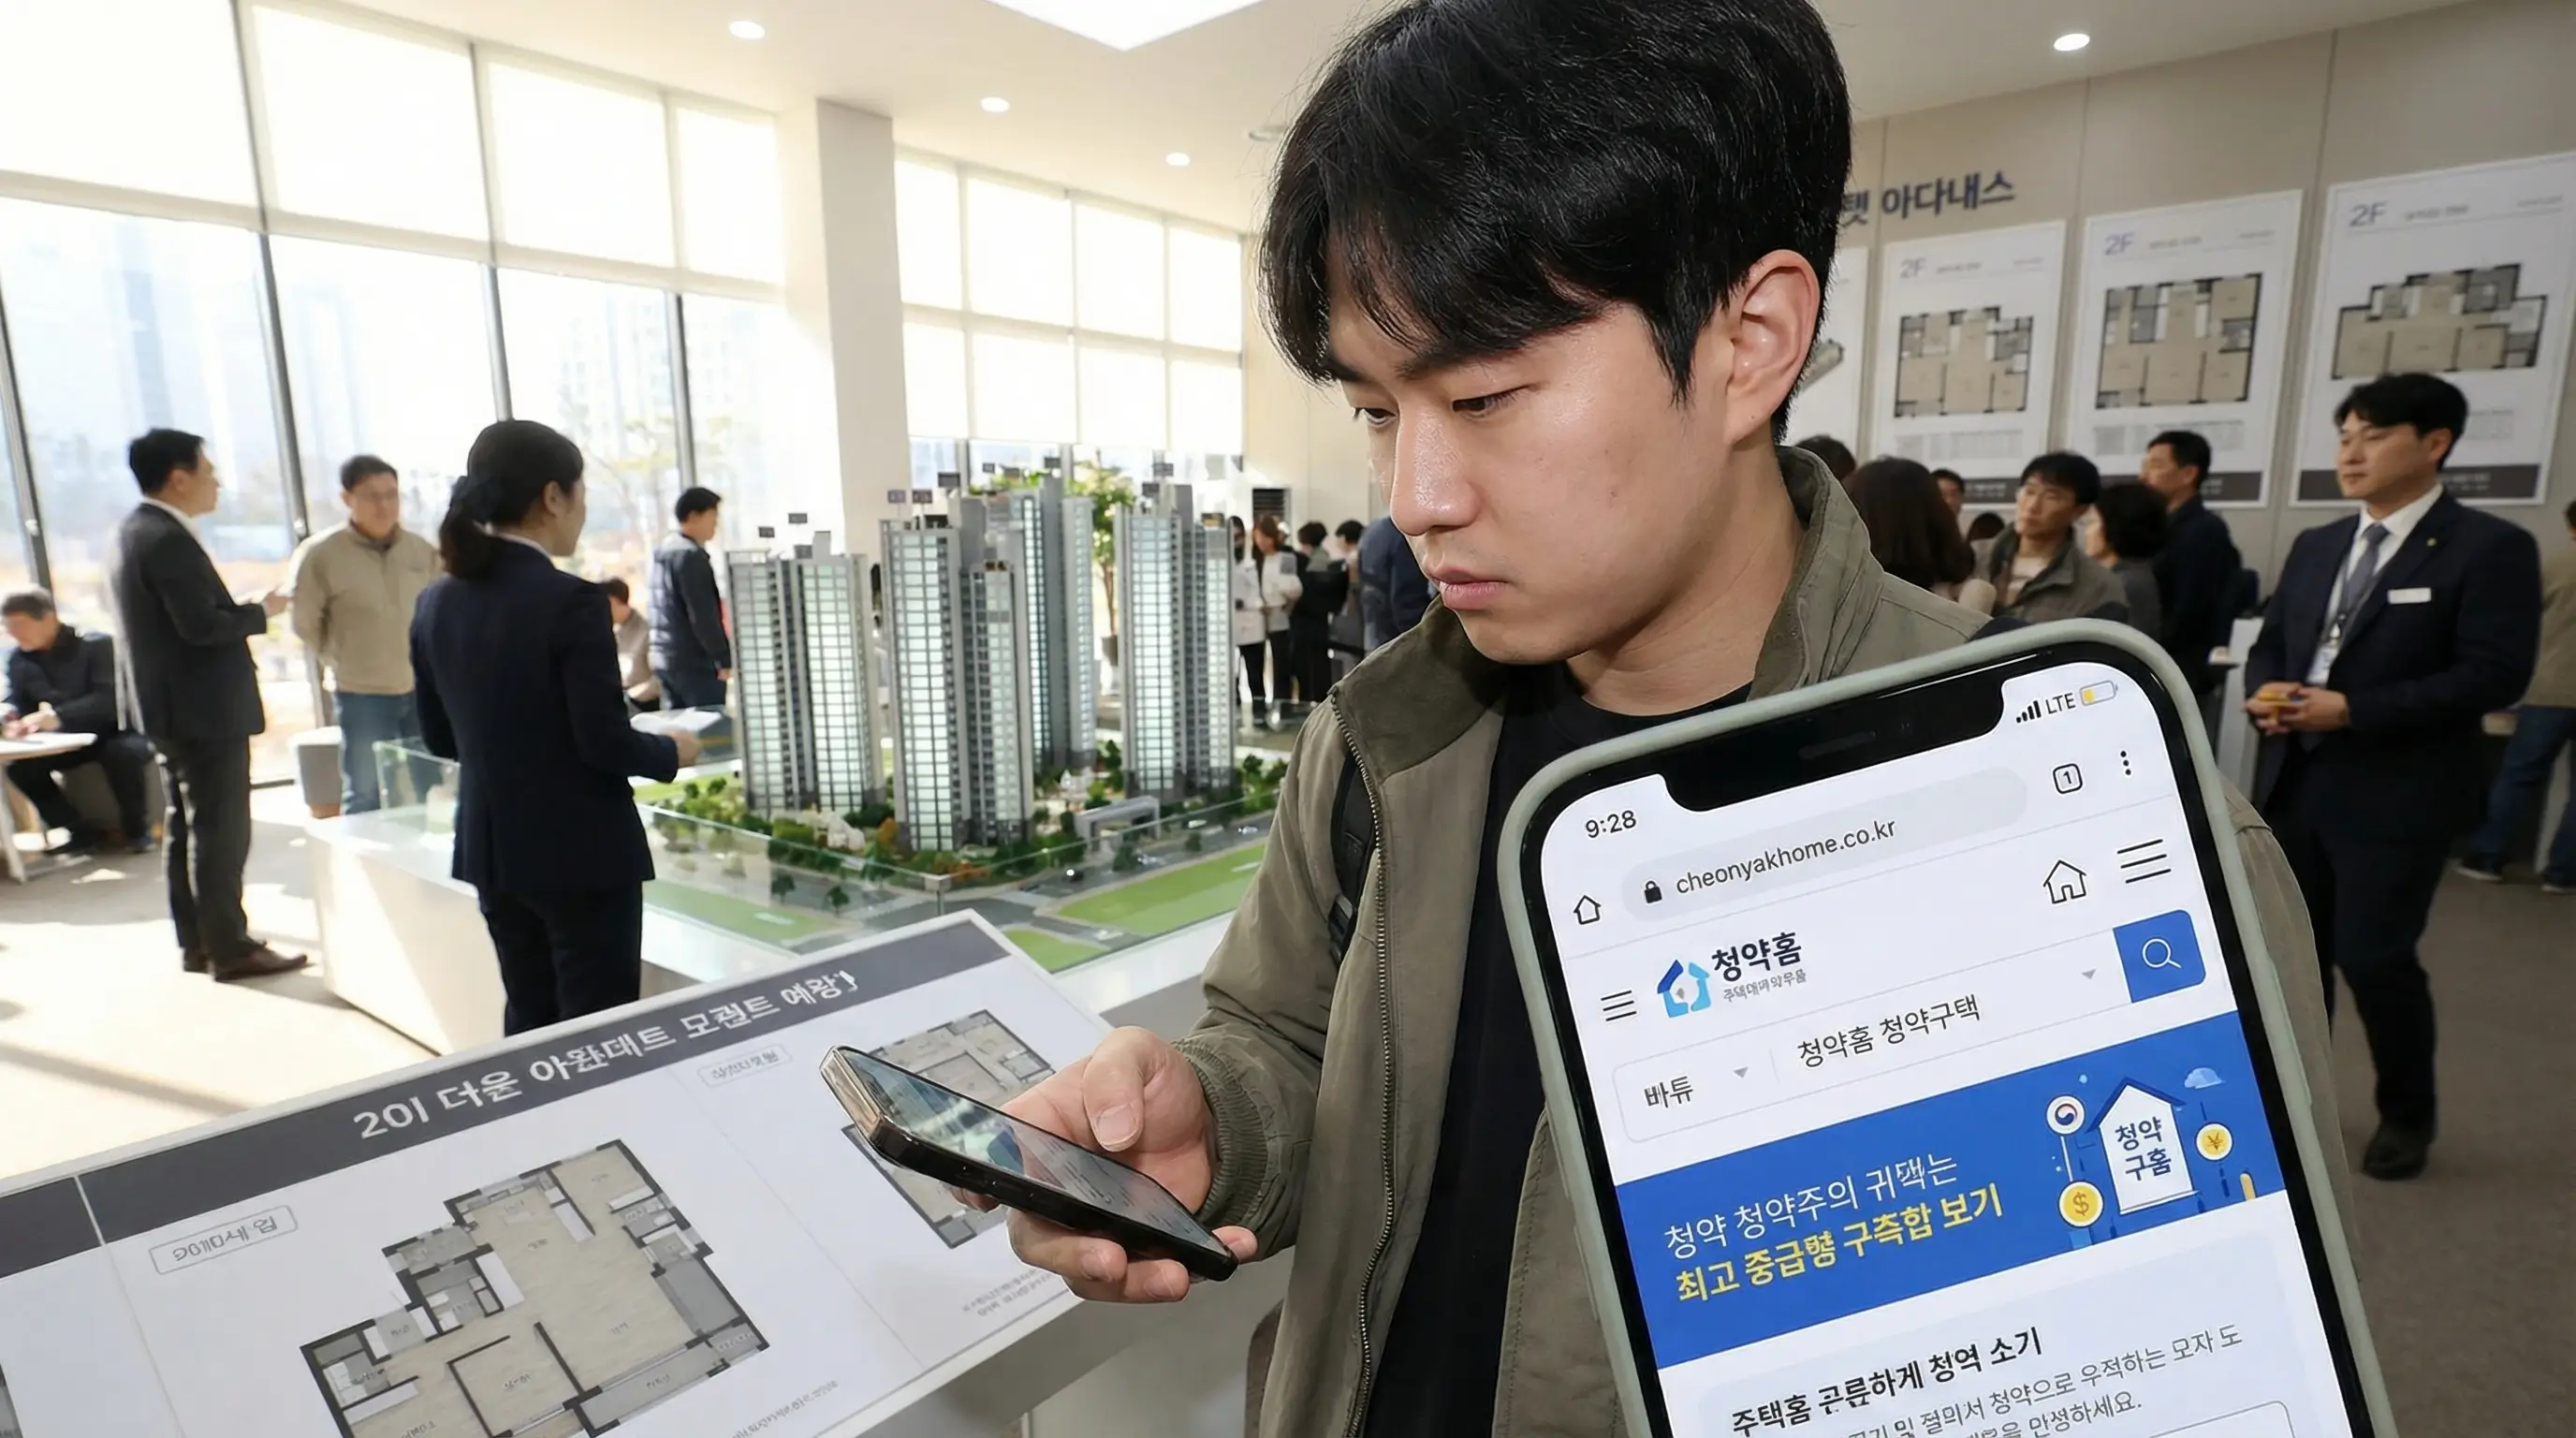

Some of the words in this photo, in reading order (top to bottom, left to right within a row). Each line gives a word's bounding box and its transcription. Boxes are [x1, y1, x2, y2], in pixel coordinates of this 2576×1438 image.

[2349, 201, 2388, 227] 2F
[2103, 231, 2135, 256] 2F
[1899, 257, 1925, 279] 2F
[2045, 693, 2076, 714] LTE
[1585, 810, 1637, 839] 9:28
[1676, 818, 1896, 894] cheonyakhome.co.kr
[1711, 932, 1802, 982] 청약홈
[1797, 1025, 1874, 1068] 청약홈
[1879, 993, 1982, 1045] 청약구택
[2115, 1115, 2162, 1151] 청약
[2125, 1147, 2173, 1181] 구홈
[1664, 1213, 1727, 1260] 청약
[1734, 1175, 1860, 1240] 청약주의
[1676, 1260, 1740, 1302] 최고
[1940, 1181, 2003, 1229] 보기
[1732, 1394, 1812, 1438] 주택홈
[1928, 1343, 1983, 1383] 청역
[1989, 1326, 2043, 1366] 소기
[1988, 1372, 2077, 1416] 청약으로
[2081, 1347, 2167, 1387] 우적하는
[2172, 1329, 2215, 1362] 모자
[2219, 1323, 2243, 1348] 도
